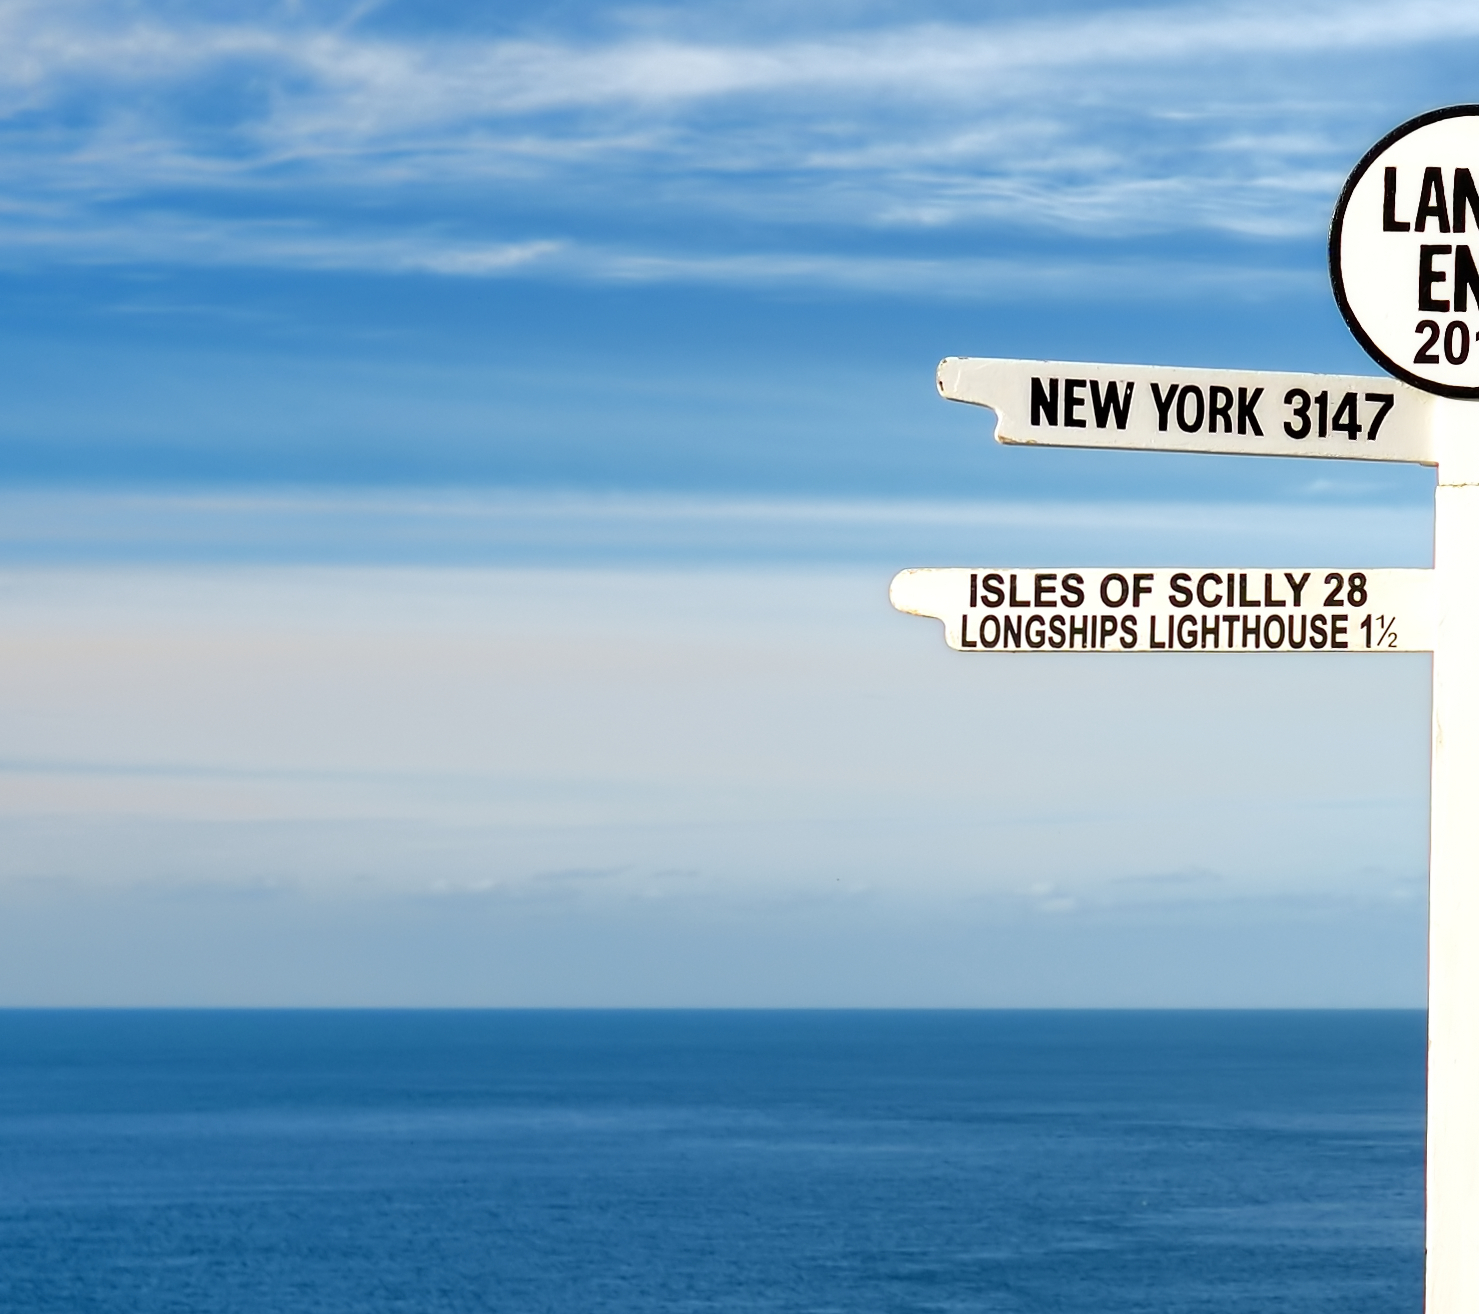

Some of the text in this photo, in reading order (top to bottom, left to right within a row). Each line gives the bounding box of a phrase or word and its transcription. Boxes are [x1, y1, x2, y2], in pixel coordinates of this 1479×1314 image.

[1030, 376, 1396, 441] NEW YORK 3147
[969, 572, 1368, 608] ISLES OF SCILLY 28
[961, 614, 1138, 649] LONGSHIPS
[1149, 614, 1349, 650] LIGHTHOUSE
